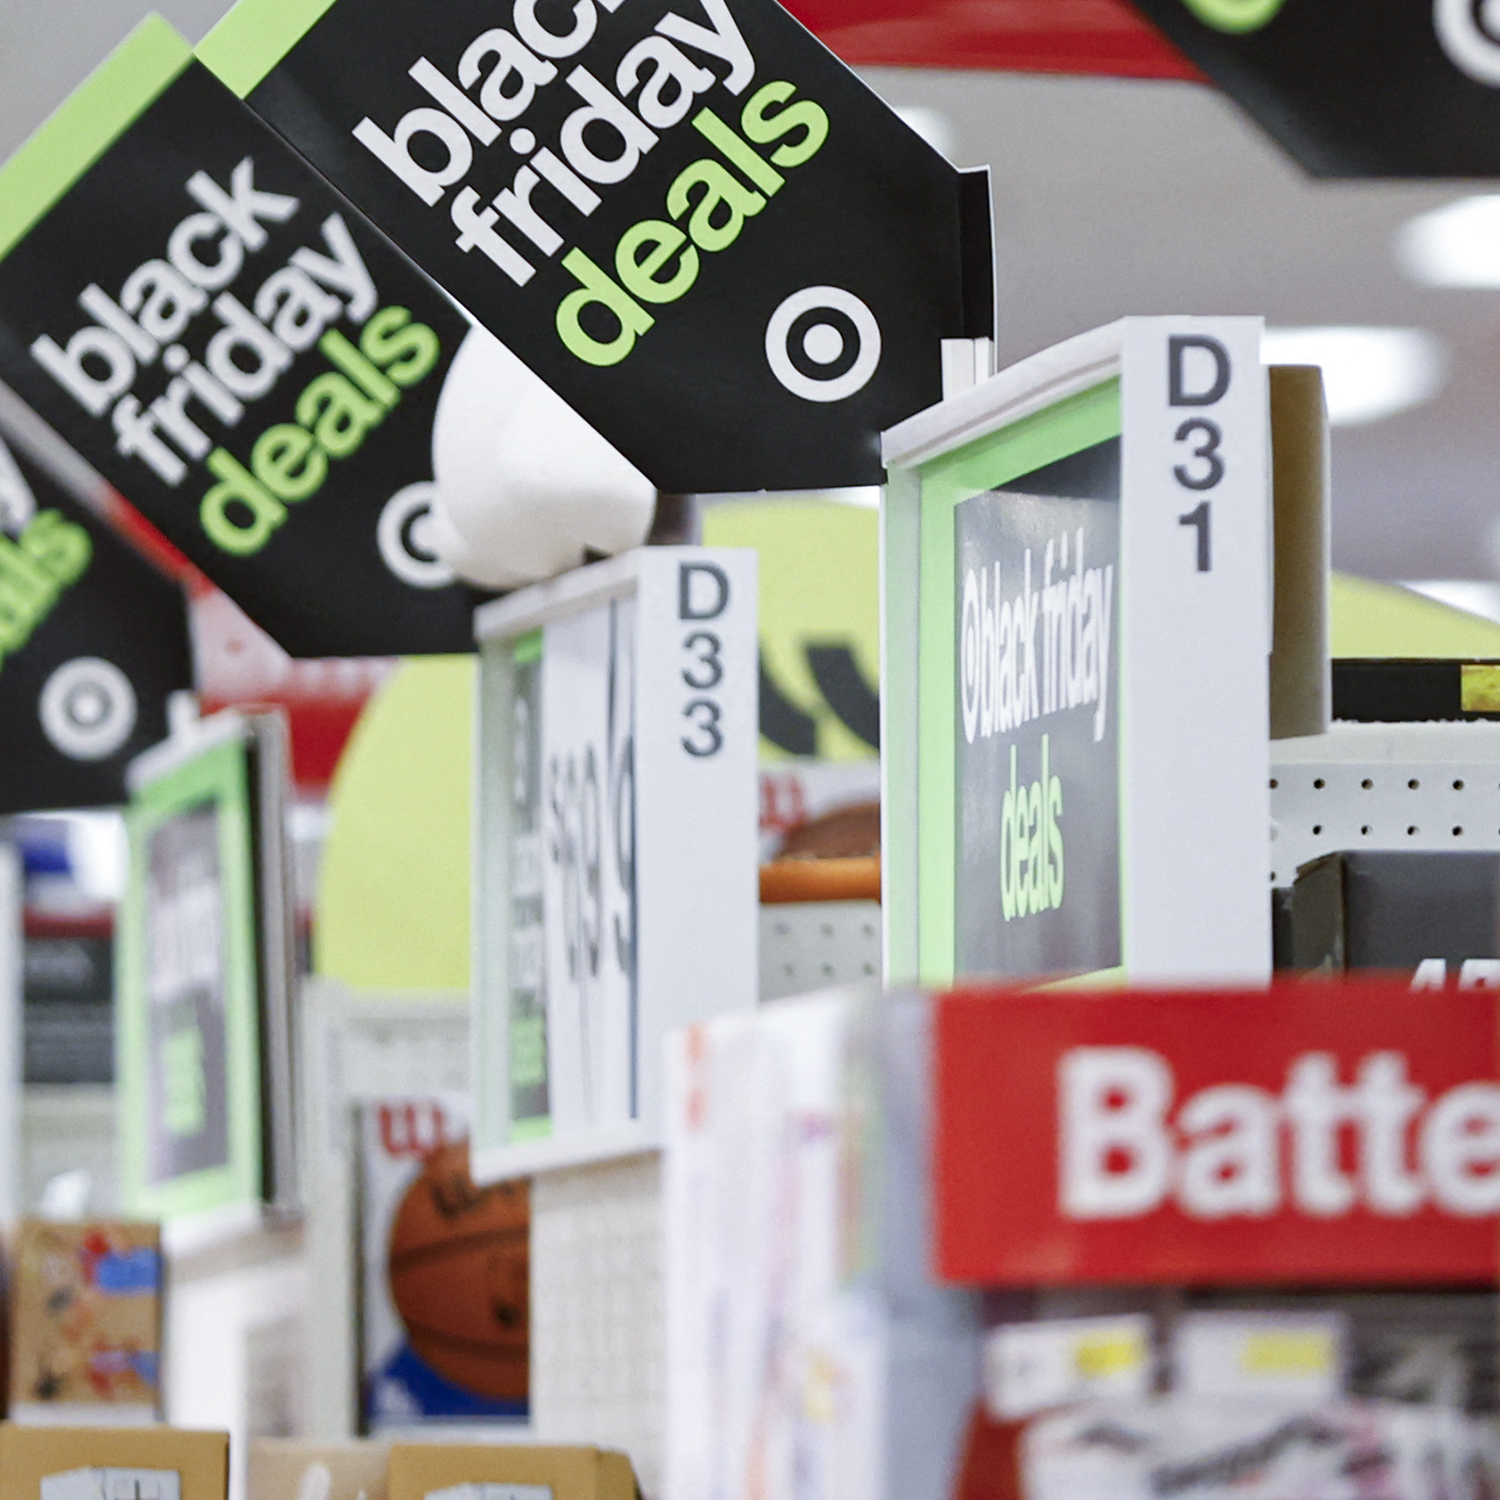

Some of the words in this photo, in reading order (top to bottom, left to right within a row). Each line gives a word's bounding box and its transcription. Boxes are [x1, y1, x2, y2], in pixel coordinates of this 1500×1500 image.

[31, 157, 299, 416] black
[555, 80, 829, 366] deals
[112, 212, 378, 487] friday
[200, 305, 440, 556] deals
[1166, 335, 1231, 572] D31
[677, 561, 729, 758] D33
[982, 548, 1041, 738] black
[1043, 527, 1113, 743] friday
[1000, 733, 1064, 922] deals
